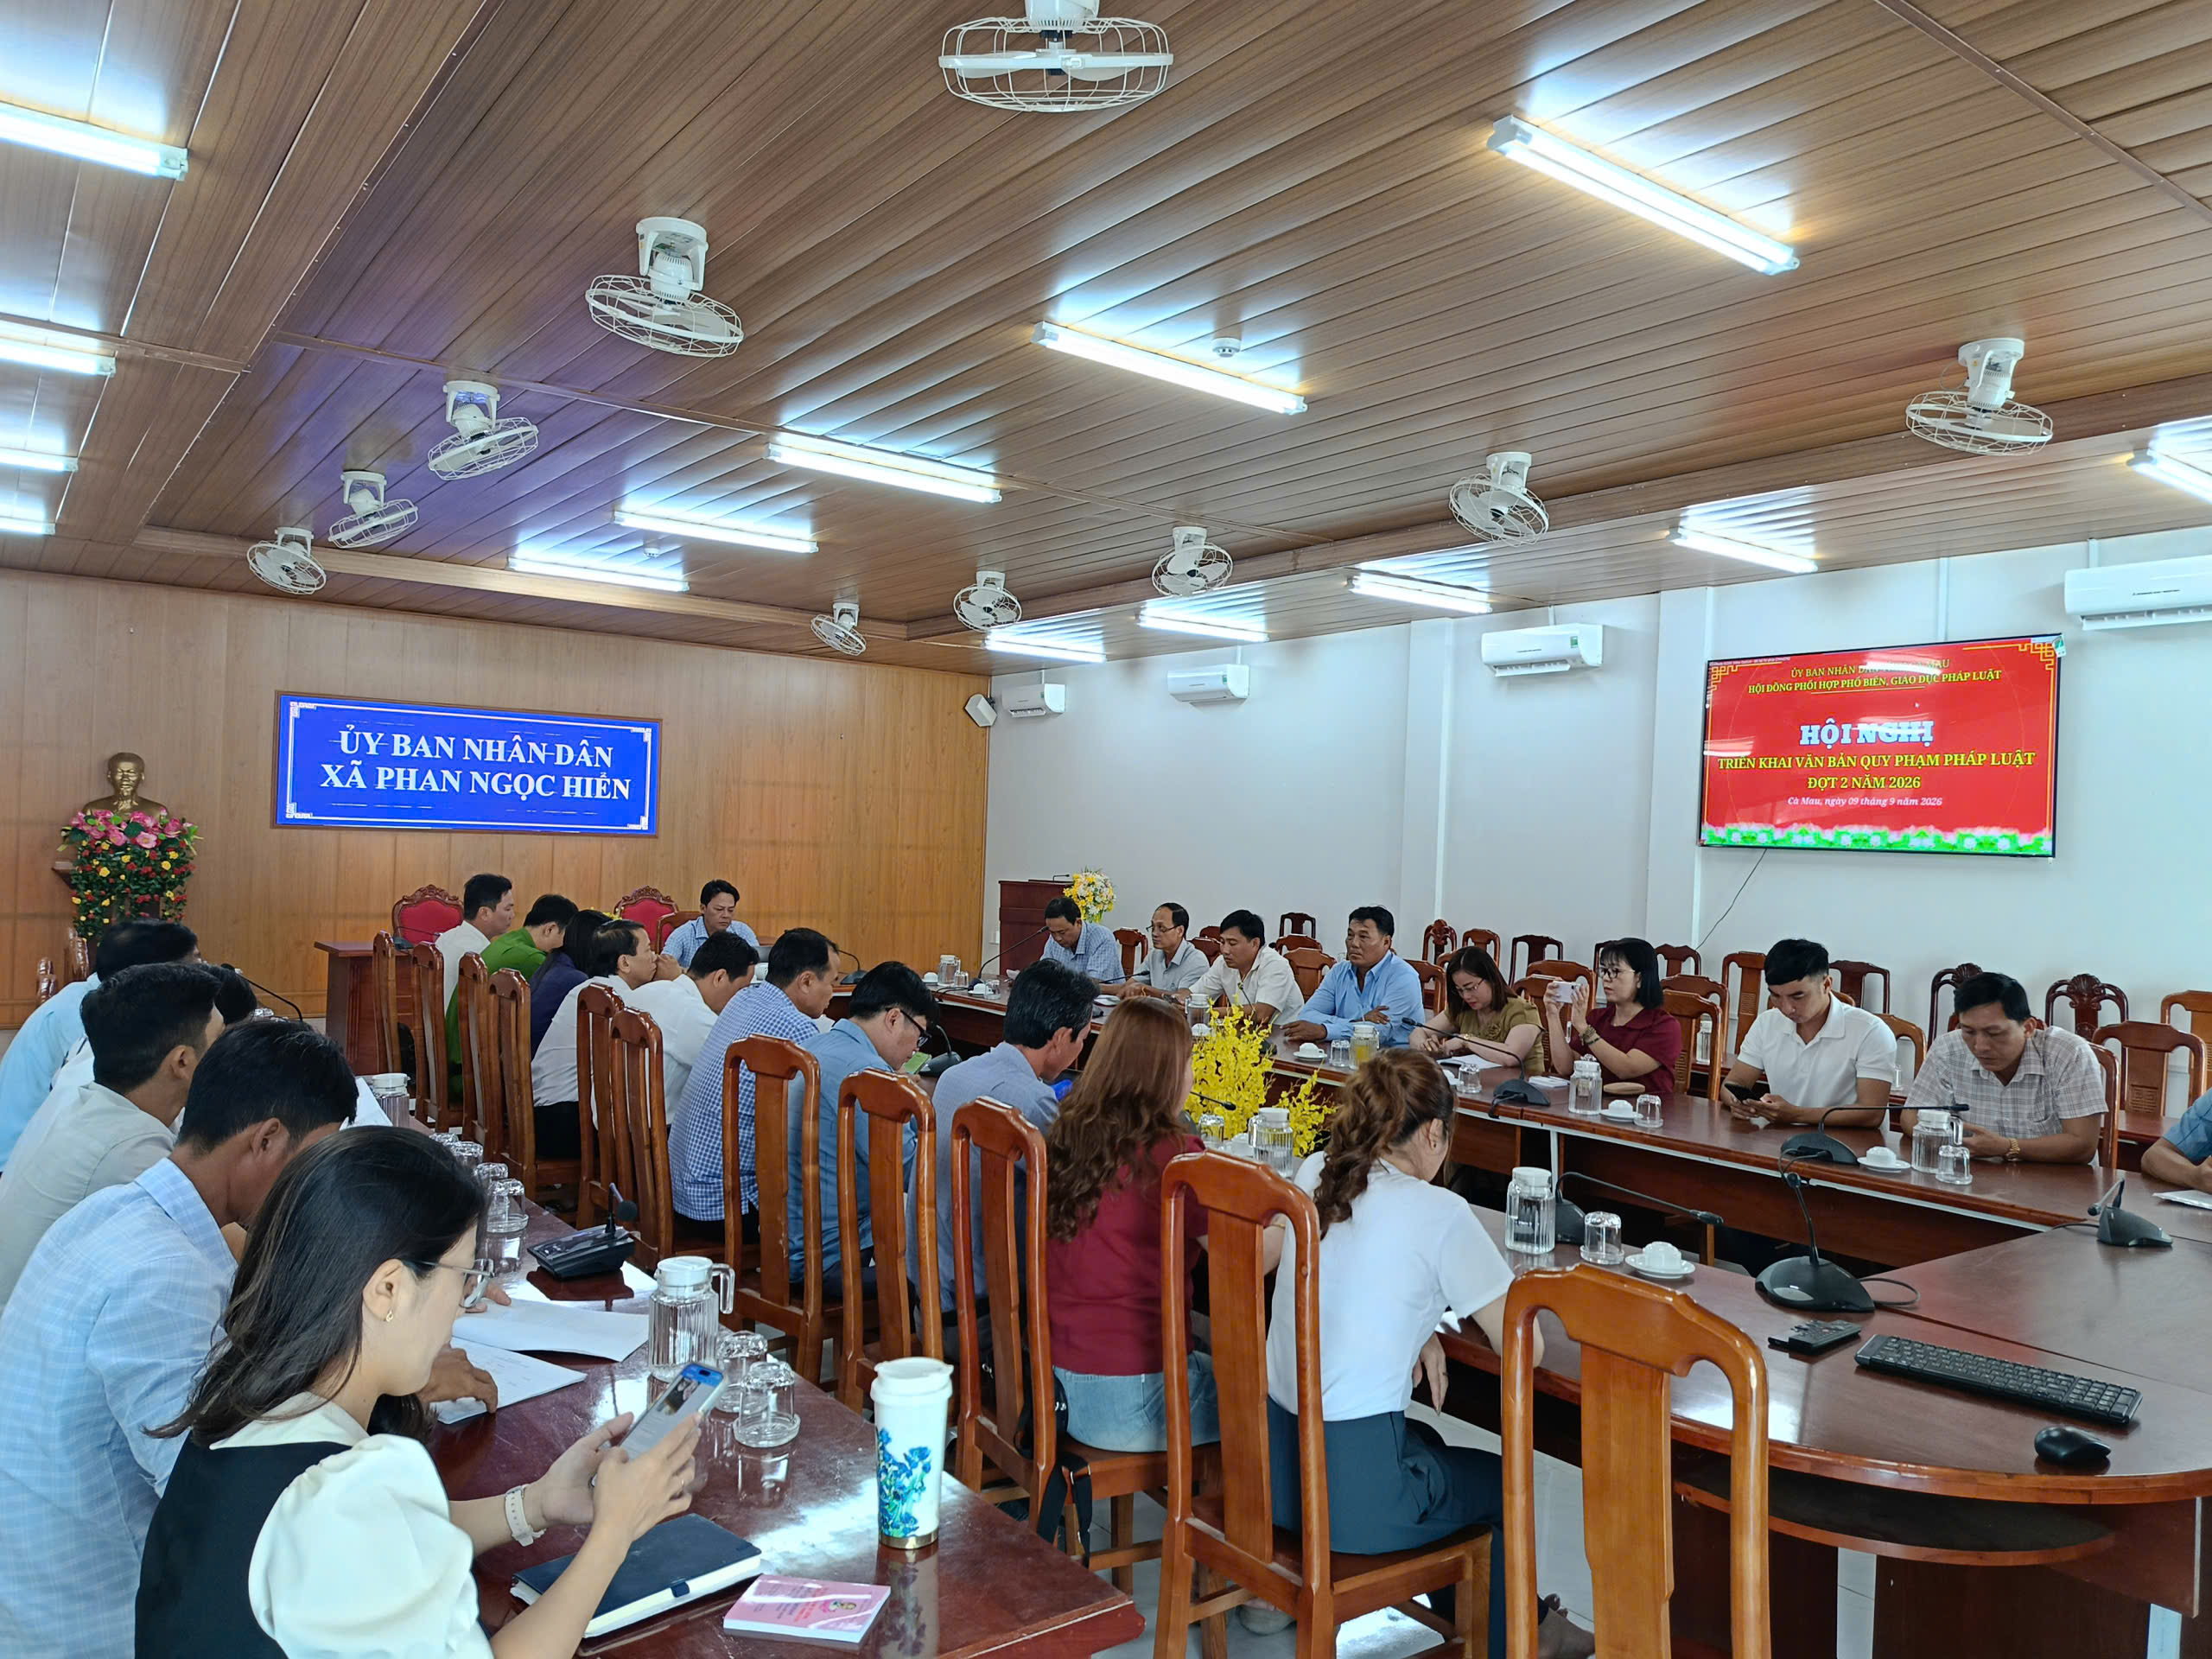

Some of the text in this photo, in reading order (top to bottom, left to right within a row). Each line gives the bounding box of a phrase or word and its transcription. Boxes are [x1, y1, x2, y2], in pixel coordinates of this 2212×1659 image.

[1748, 683, 1765, 695] HỘI
[1819, 679, 1840, 691] HỢP
[1891, 674, 1916, 685] GIÁO
[1918, 674, 1939, 685] DỤC
[1942, 671, 1971, 683] PHÁP
[1973, 668, 2002, 682] LUẬT
[1805, 668, 1825, 677] BAN
[1827, 665, 1855, 676] NHÂN
[1799, 717, 1935, 750] HỘI NGHỊ
[339, 724, 613, 768] ỦY BAN NHÂN DÂN
[1758, 756, 1793, 769] KHAI
[1795, 753, 1825, 768] VĂN
[1827, 753, 1857, 767] BẢN
[1860, 754, 1892, 771] QUY
[1894, 753, 1940, 769] PHẠM
[1943, 750, 1987, 766] PHÁP
[1990, 749, 2036, 769] LUẬT
[320, 760, 367, 789] XÃ
[374, 766, 462, 793] PHAN
[469, 772, 556, 801] NGỌC
[1808, 774, 1921, 791] ĐỢT 2 NĂM 2026
[1787, 797, 1799, 805] Cà
[1824, 797, 1847, 807] ngày
[1848, 797, 1859, 805] 09
[1860, 797, 1887, 808] tháng
[1889, 798, 1895, 806] 9
[1897, 798, 1918, 806] năm
